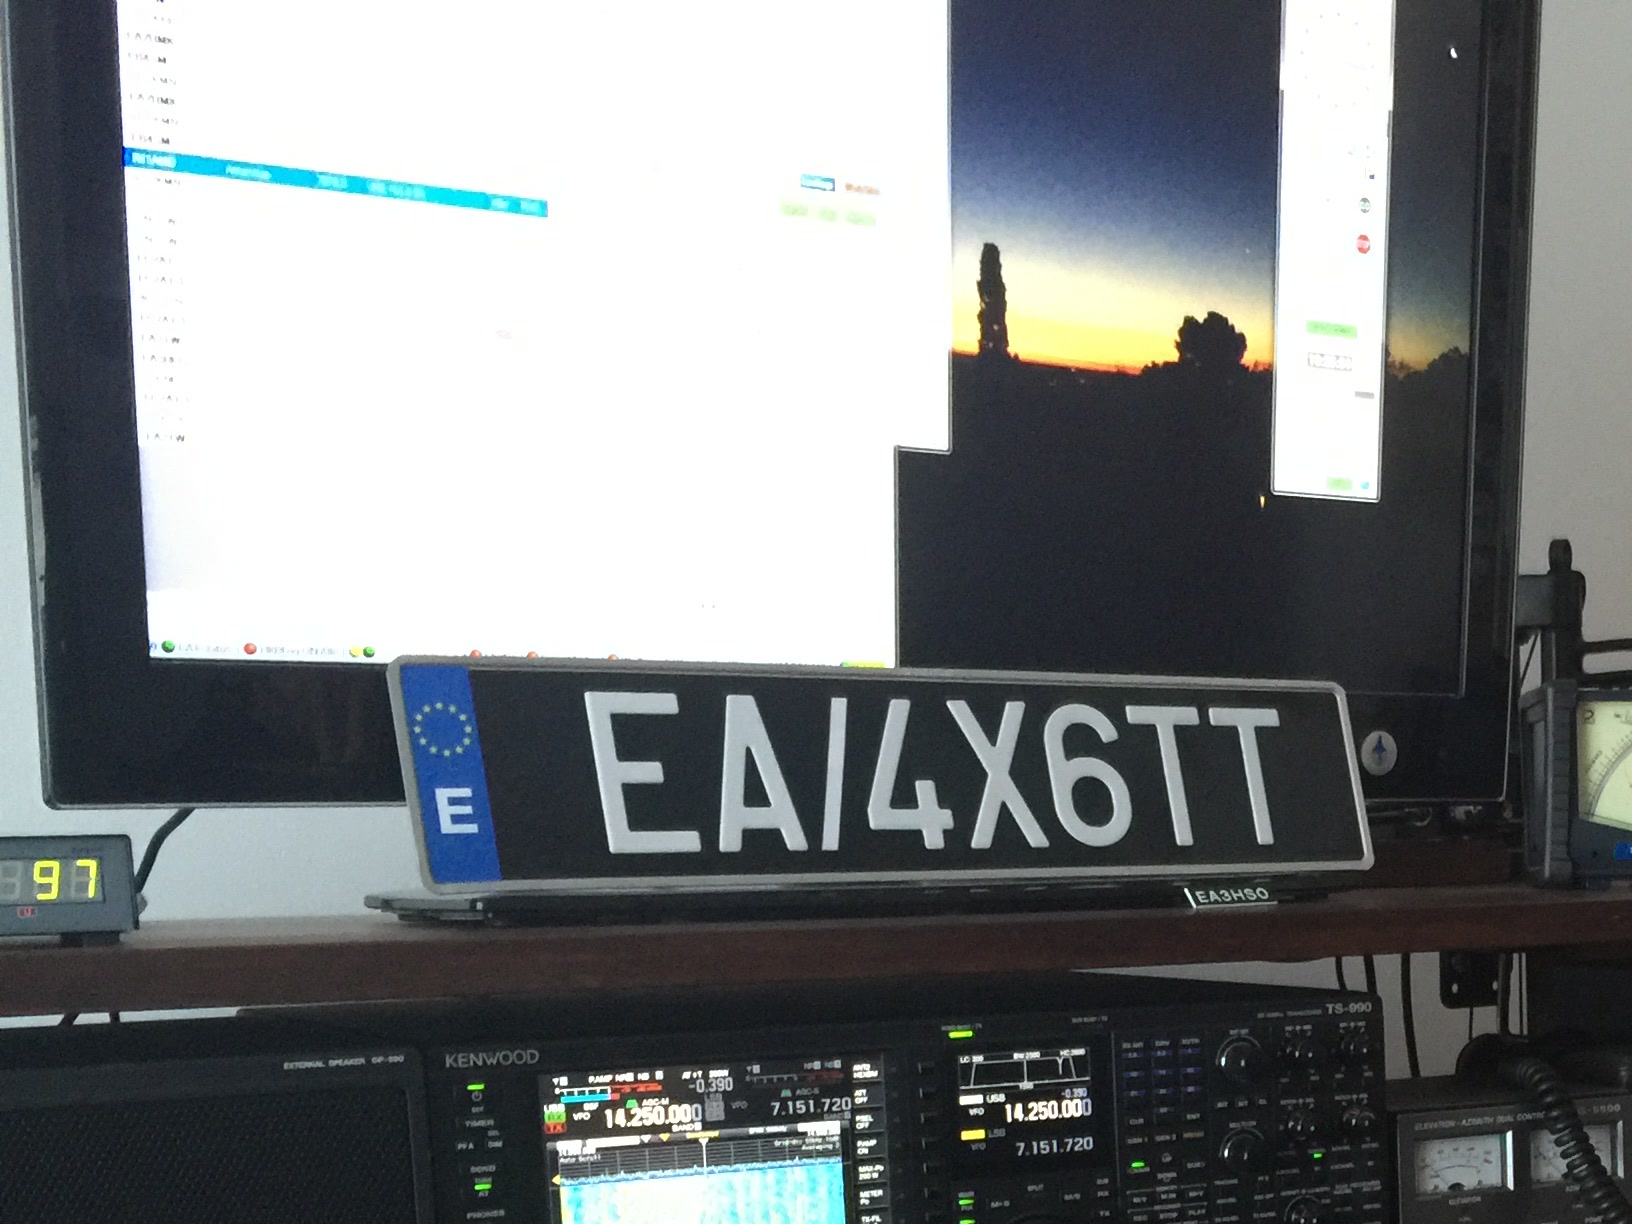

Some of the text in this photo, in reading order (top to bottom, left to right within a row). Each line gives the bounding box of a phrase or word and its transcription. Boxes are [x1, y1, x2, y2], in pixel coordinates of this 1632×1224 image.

[434, 786, 480, 835] E
[33, 858, 98, 901] 97
[1195, 887, 1269, 903] EA3HSO
[1325, 1001, 1373, 1015] TS-990
[328, 1057, 366, 1067] SPEAKER
[445, 1049, 540, 1069] KENWOOD
[688, 1077, 734, 1094] -0.390
[770, 1096, 852, 1117] 7.151.720
[986, 1093, 1006, 1104] USB
[572, 1111, 591, 1121] VFO
[604, 1103, 703, 1129] 14.250.000
[968, 1107, 985, 1116] VFO
[1004, 1097, 1093, 1124] 14.250.000
[1414, 1120, 1456, 1131] ELEVATION
[1015, 1136, 1095, 1157] 7.151.720
[859, 1189, 884, 1198] METER
[466, 1209, 505, 1220] PHONES
